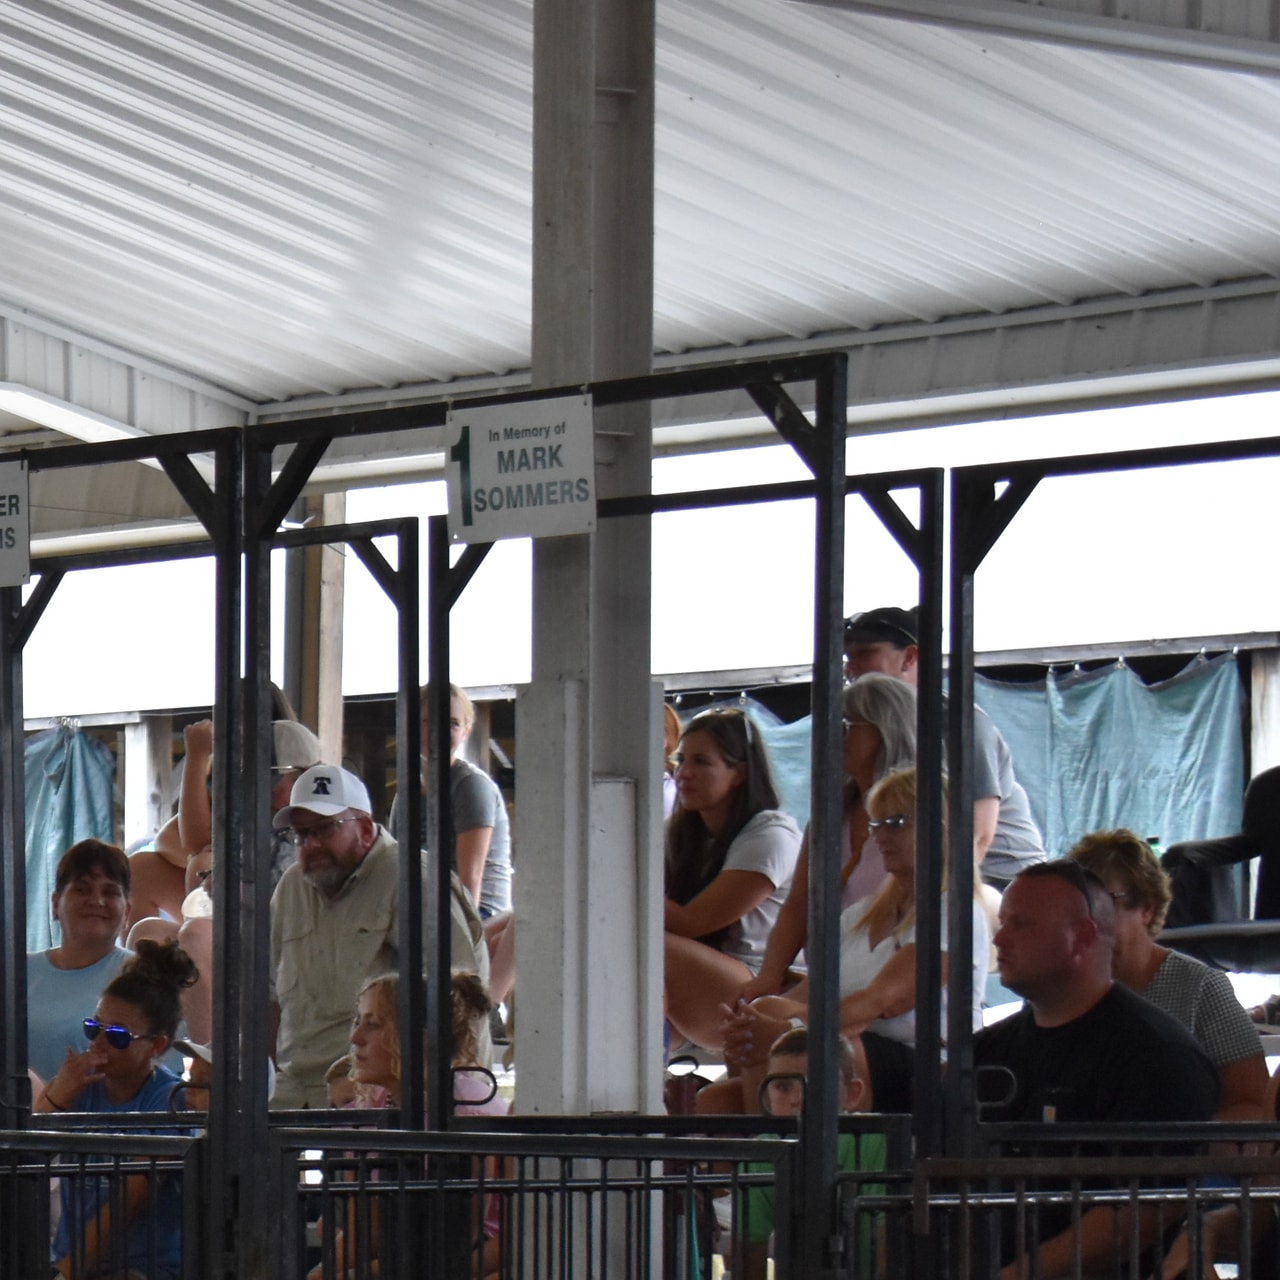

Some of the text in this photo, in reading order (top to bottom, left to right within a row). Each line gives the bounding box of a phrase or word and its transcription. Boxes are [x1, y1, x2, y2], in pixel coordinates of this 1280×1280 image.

[489, 421, 567, 442] In Memory of
[497, 444, 564, 474] MARK
[450, 425, 473, 526] 1
[474, 478, 589, 512] SOMMERS
